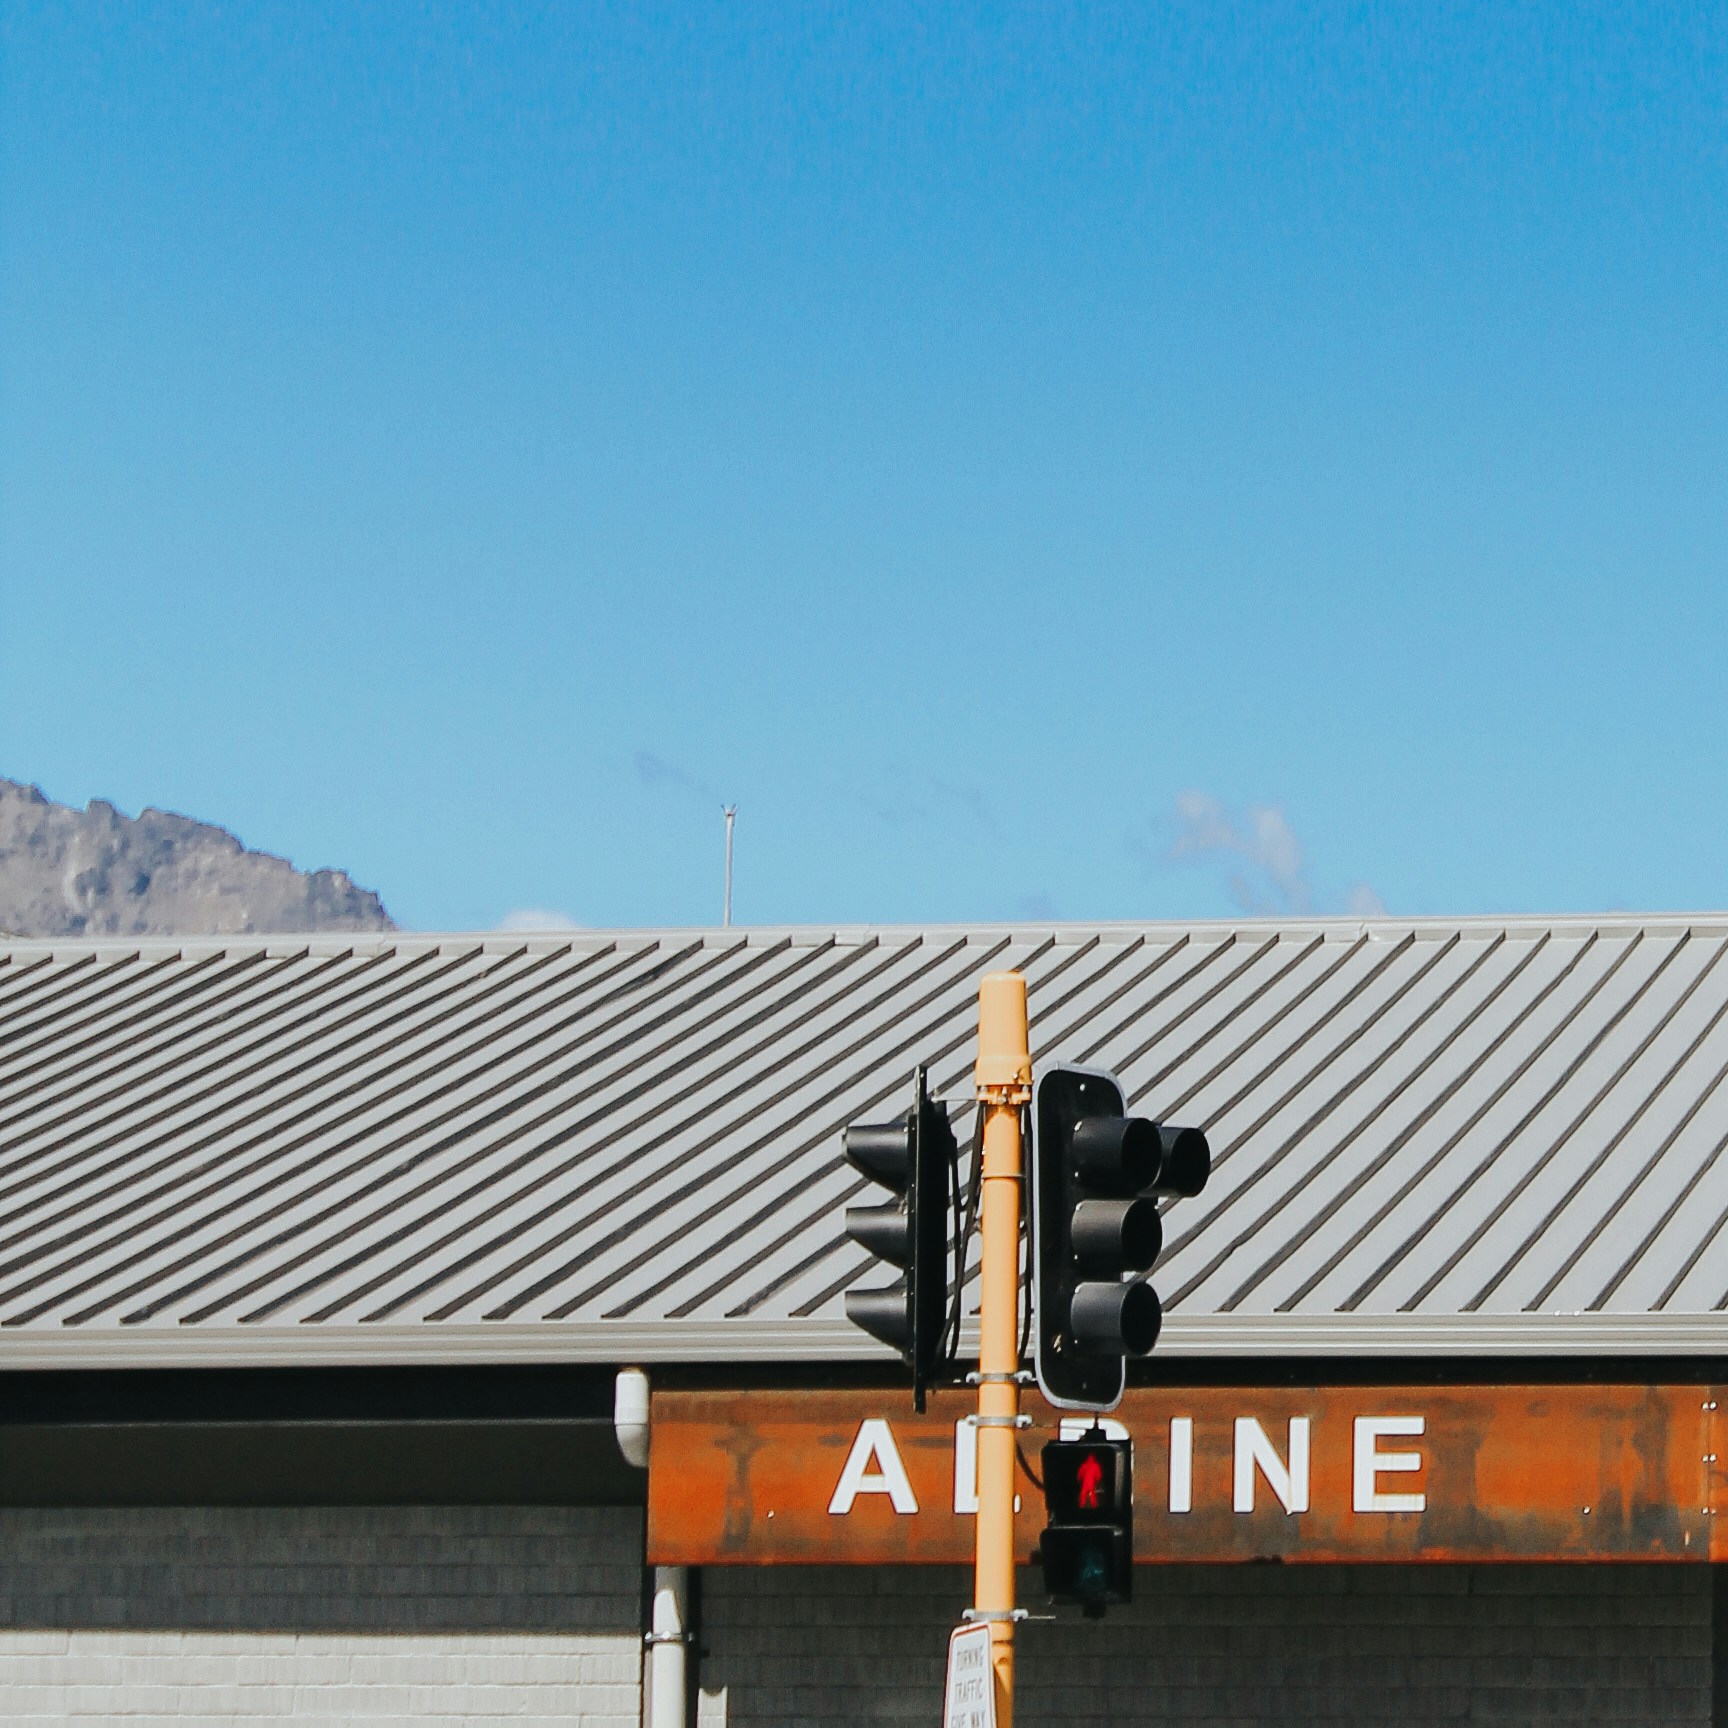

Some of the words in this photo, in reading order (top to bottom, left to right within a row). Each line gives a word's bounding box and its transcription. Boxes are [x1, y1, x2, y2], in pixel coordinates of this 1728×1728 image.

[827, 1415, 1428, 1515] ALINE
[957, 1646, 984, 1671] TURNING
[954, 1678, 984, 1704] TRAFFIC
